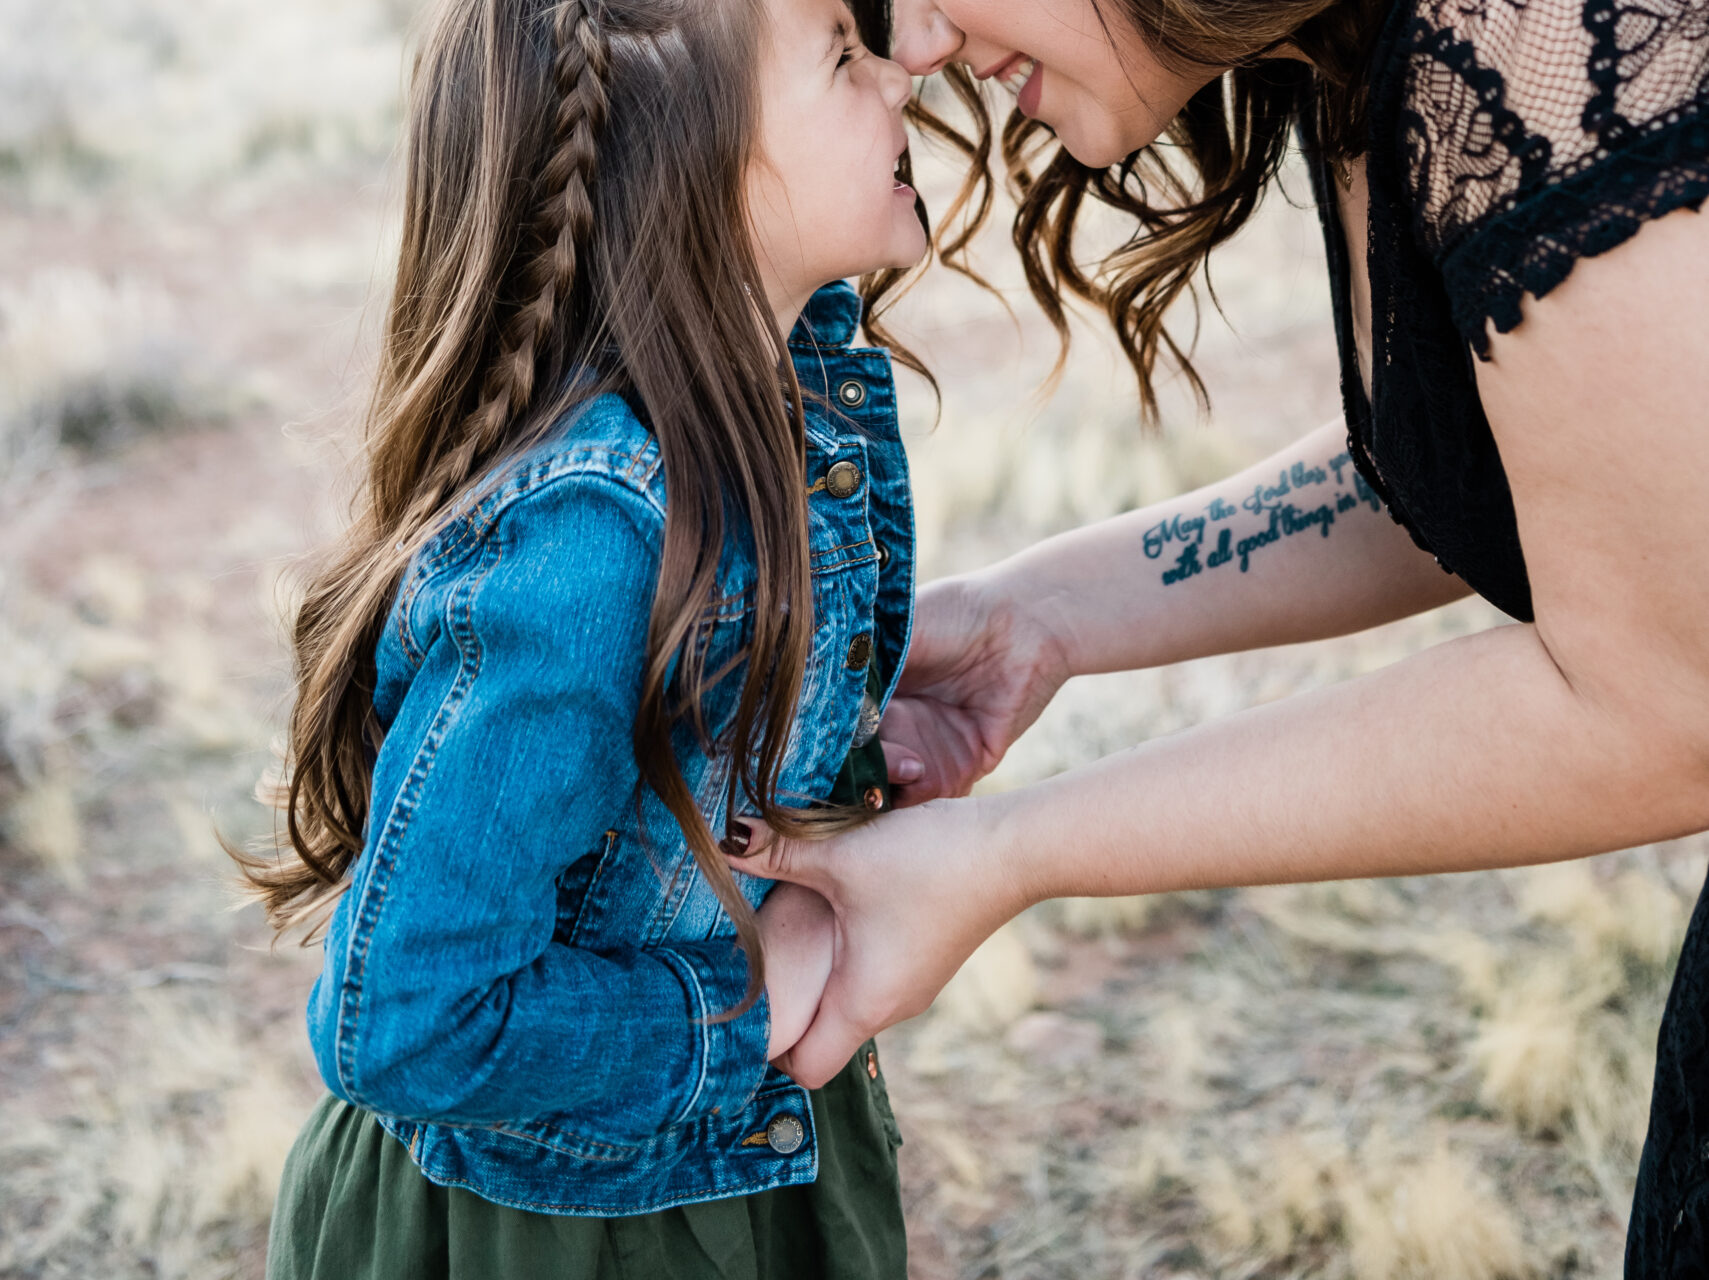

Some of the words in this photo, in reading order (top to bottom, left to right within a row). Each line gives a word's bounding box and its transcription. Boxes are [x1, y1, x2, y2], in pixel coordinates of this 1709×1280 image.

[1142, 513, 1206, 558] May
[1205, 496, 1237, 522] the
[1242, 470, 1291, 515] Lord
[1162, 542, 1203, 586] with
[1207, 528, 1233, 568] all
[1237, 508, 1280, 572] good
[1281, 503, 1335, 538] things
[1335, 493, 1357, 514] in
